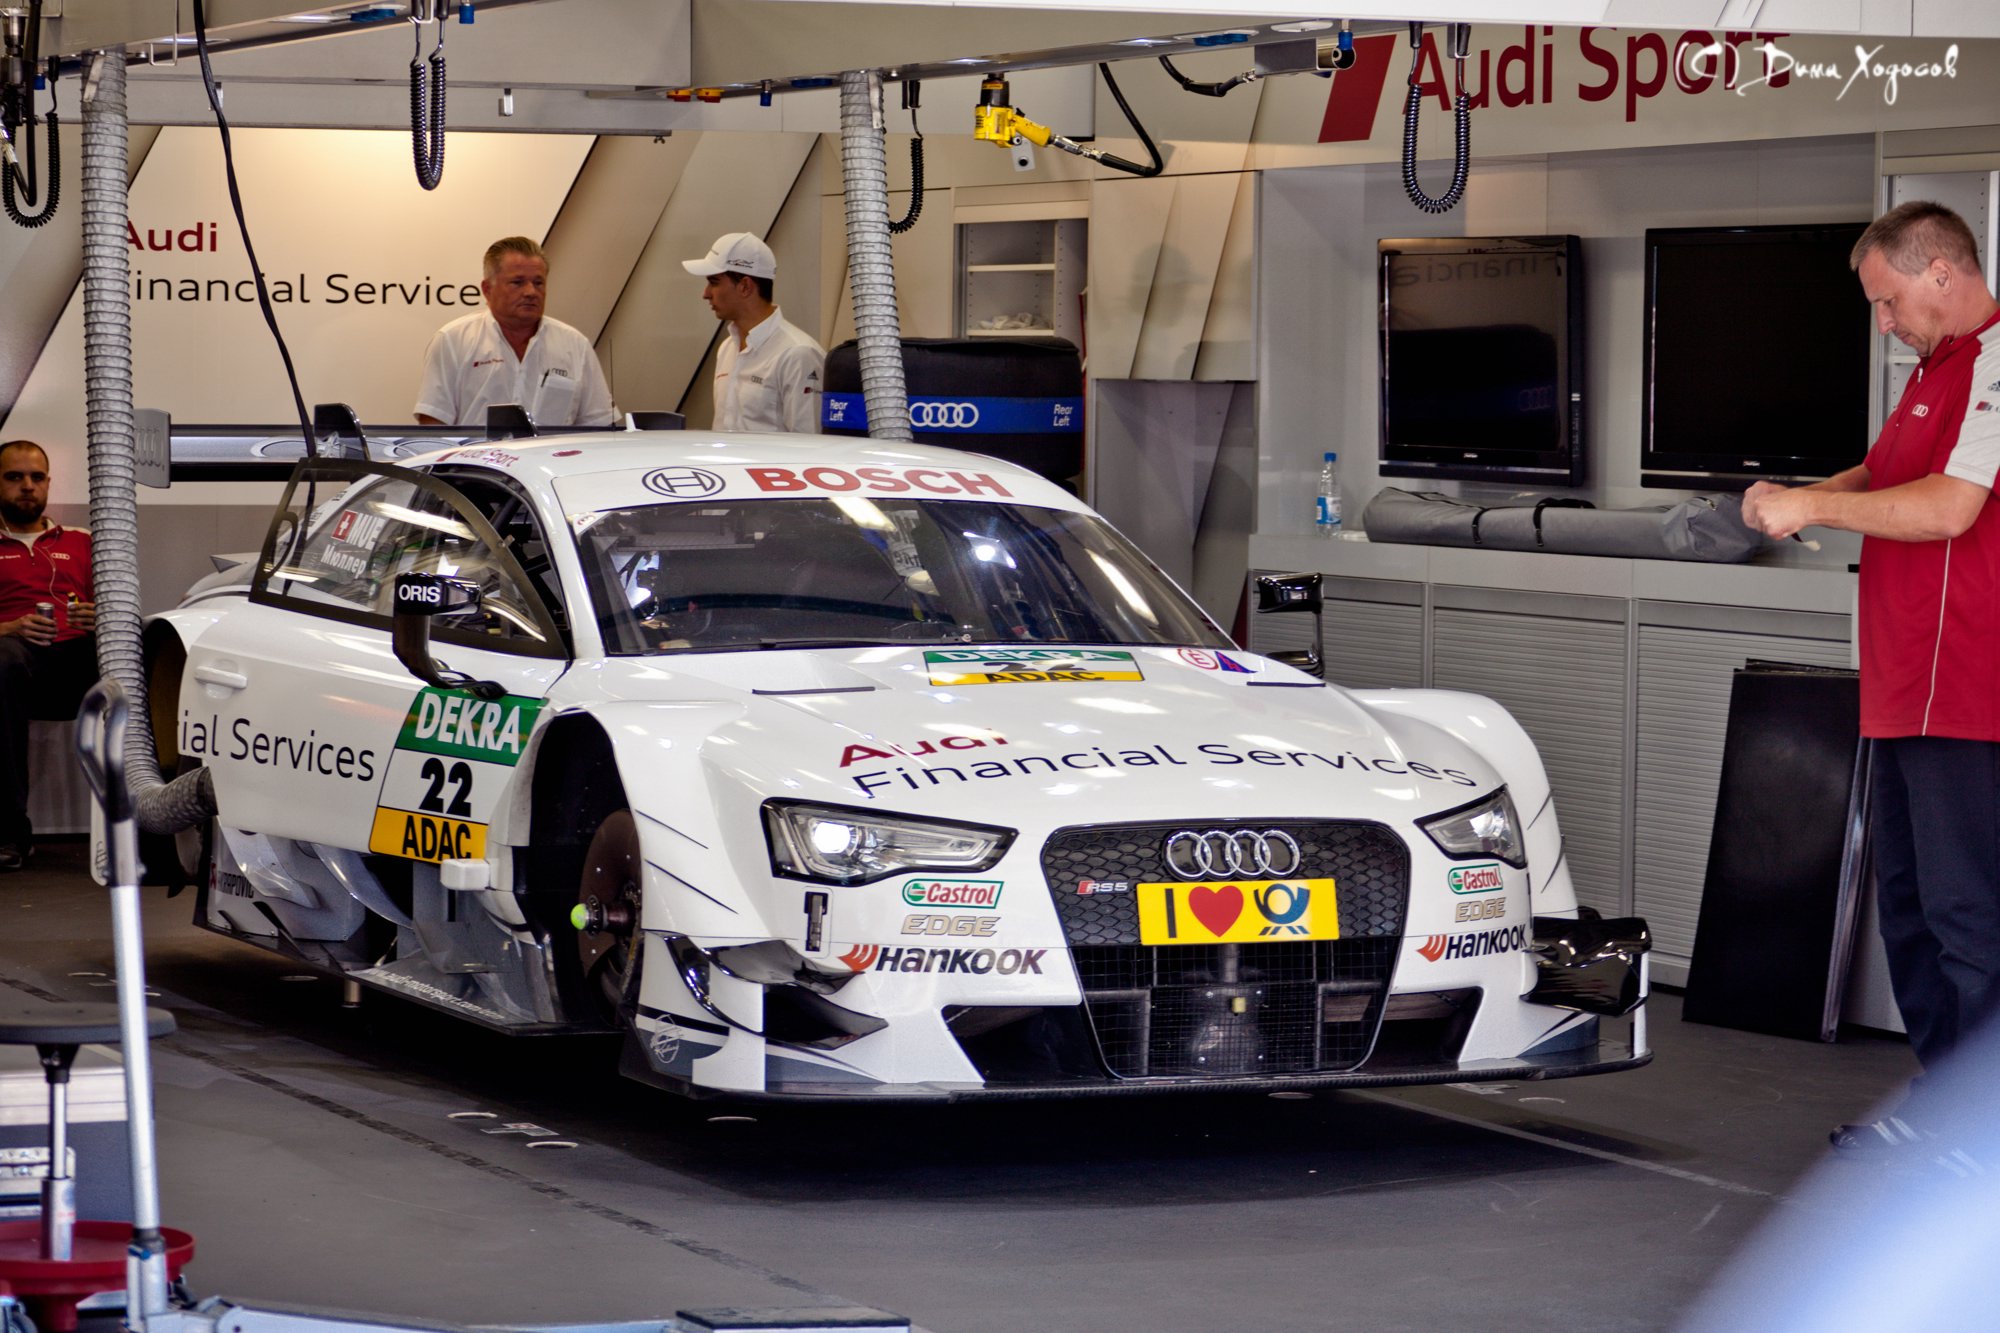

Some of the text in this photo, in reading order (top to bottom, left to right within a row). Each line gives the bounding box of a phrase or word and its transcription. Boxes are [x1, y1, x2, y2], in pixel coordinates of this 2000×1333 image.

[1402, 25, 1791, 122] Audi Sport
[128, 270, 481, 306] inancal Service
[829, 399, 848, 410] Rear
[829, 410, 844, 422] Left
[1053, 403, 1073, 415] Rear
[1053, 415, 1071, 427] Left
[744, 466, 1015, 498] BOSCH
[398, 584, 441, 603] ORIS
[936, 651, 1123, 661] DEKRA
[984, 671, 1106, 683] ADAC
[415, 692, 521, 755] DEKRA
[230, 717, 375, 782] Services
[852, 744, 1478, 799] Financial Services
[418, 757, 473, 818] 22
[402, 815, 472, 861] ADAC
[1463, 868, 1502, 890] Castrol
[926, 882, 996, 905] Castrol
[1455, 897, 1507, 923] EDGE
[900, 914, 1001, 938] EDGE
